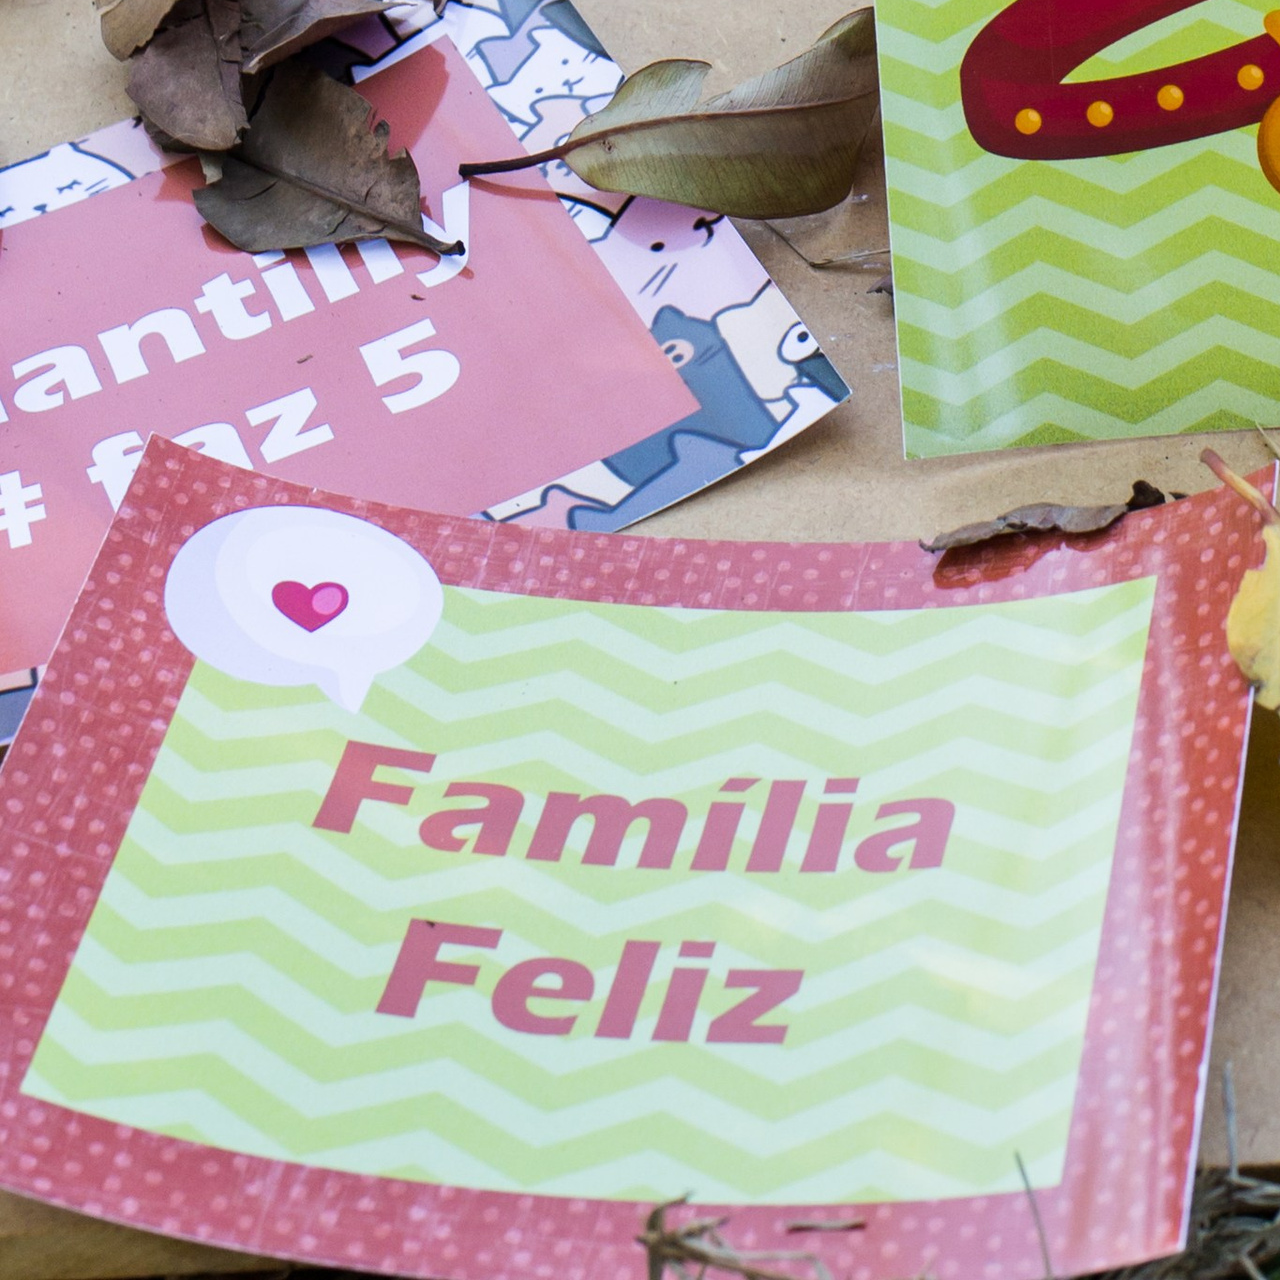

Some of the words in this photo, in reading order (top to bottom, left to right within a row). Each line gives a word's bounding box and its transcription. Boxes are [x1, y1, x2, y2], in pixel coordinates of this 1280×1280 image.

[0, 180, 470, 424] antilly
[359, 317, 461, 415] 5
[311, 739, 957, 874] Família
[375, 917, 806, 1045] Feliz
